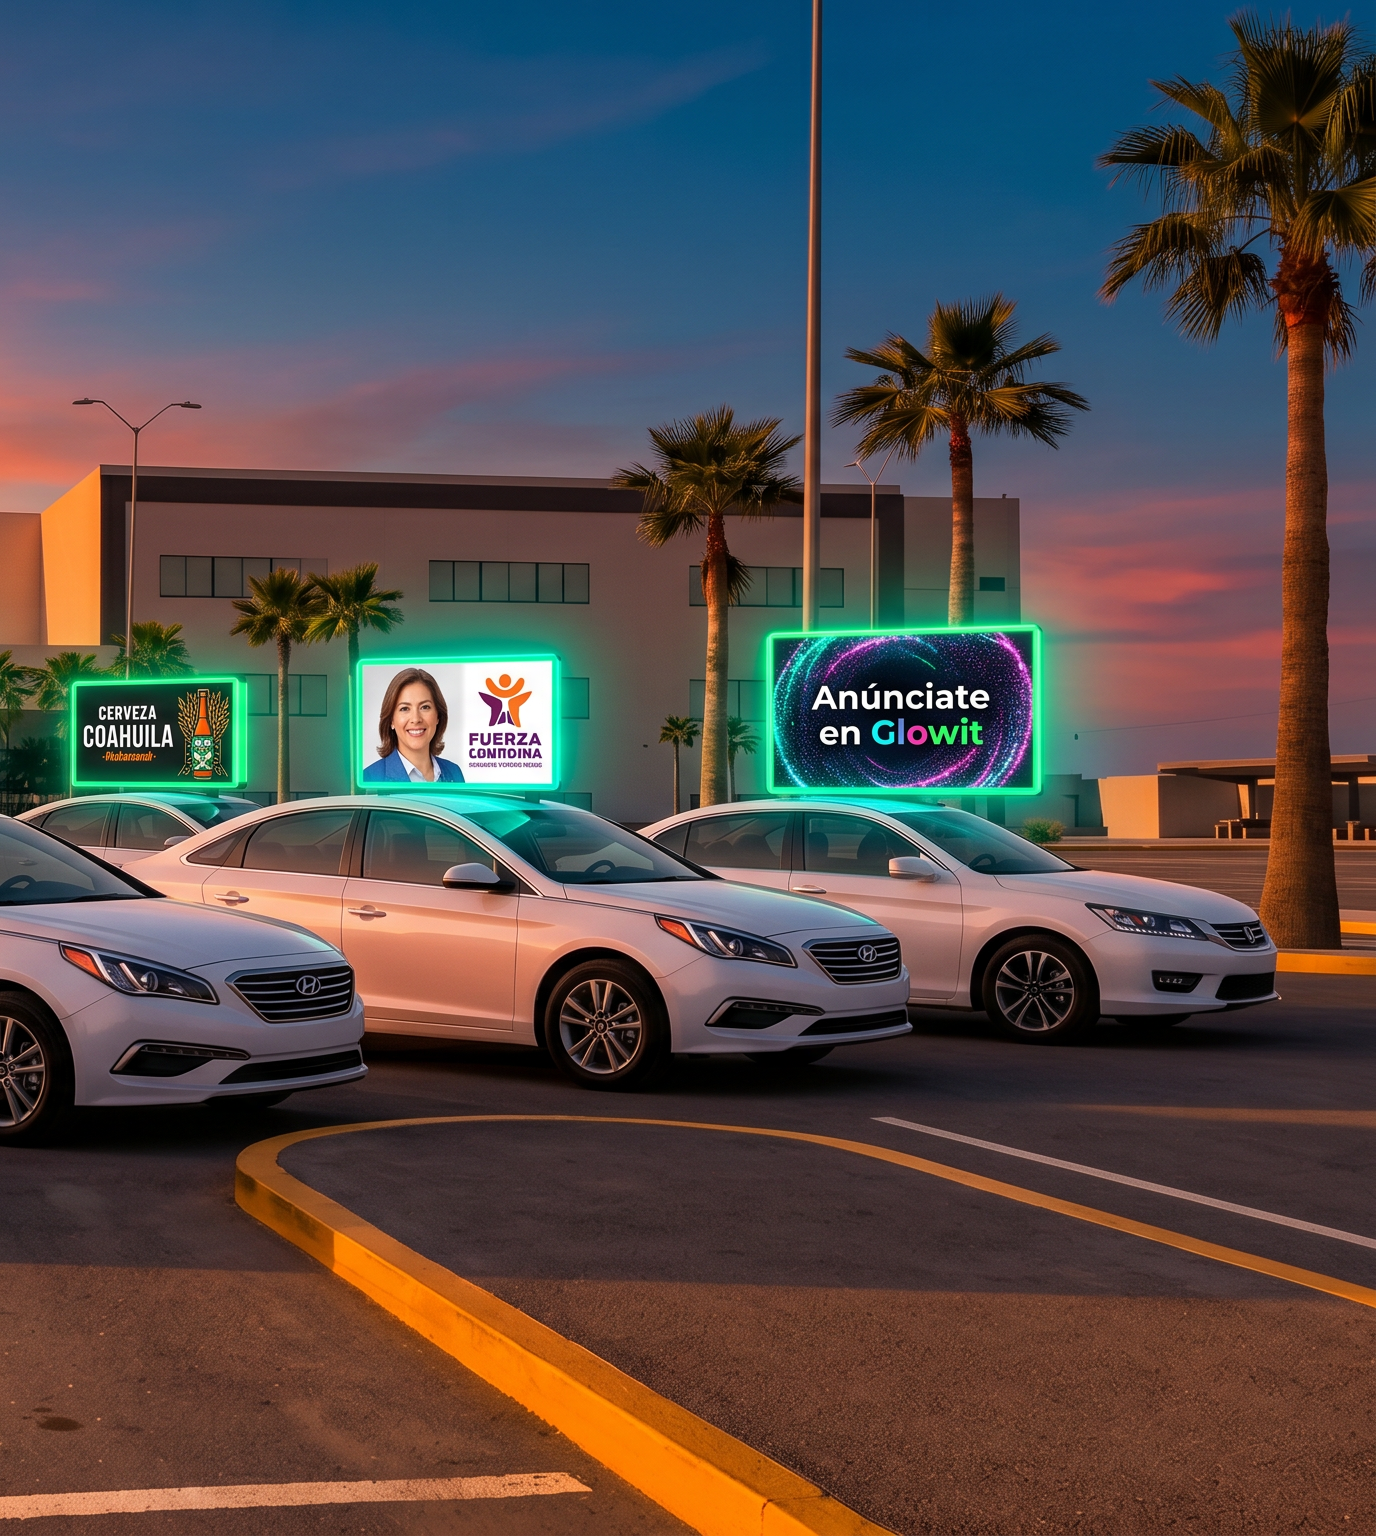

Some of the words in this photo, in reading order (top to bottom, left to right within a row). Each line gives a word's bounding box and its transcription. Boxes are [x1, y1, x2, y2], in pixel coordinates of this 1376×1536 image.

[811, 682, 990, 711] Anúnciate
[98, 705, 157, 721] CERVEZA
[83, 724, 174, 748] COAHUILA
[469, 732, 542, 746] FUERZA
[819, 725, 861, 746] en
[871, 717, 984, 746] Glowit
